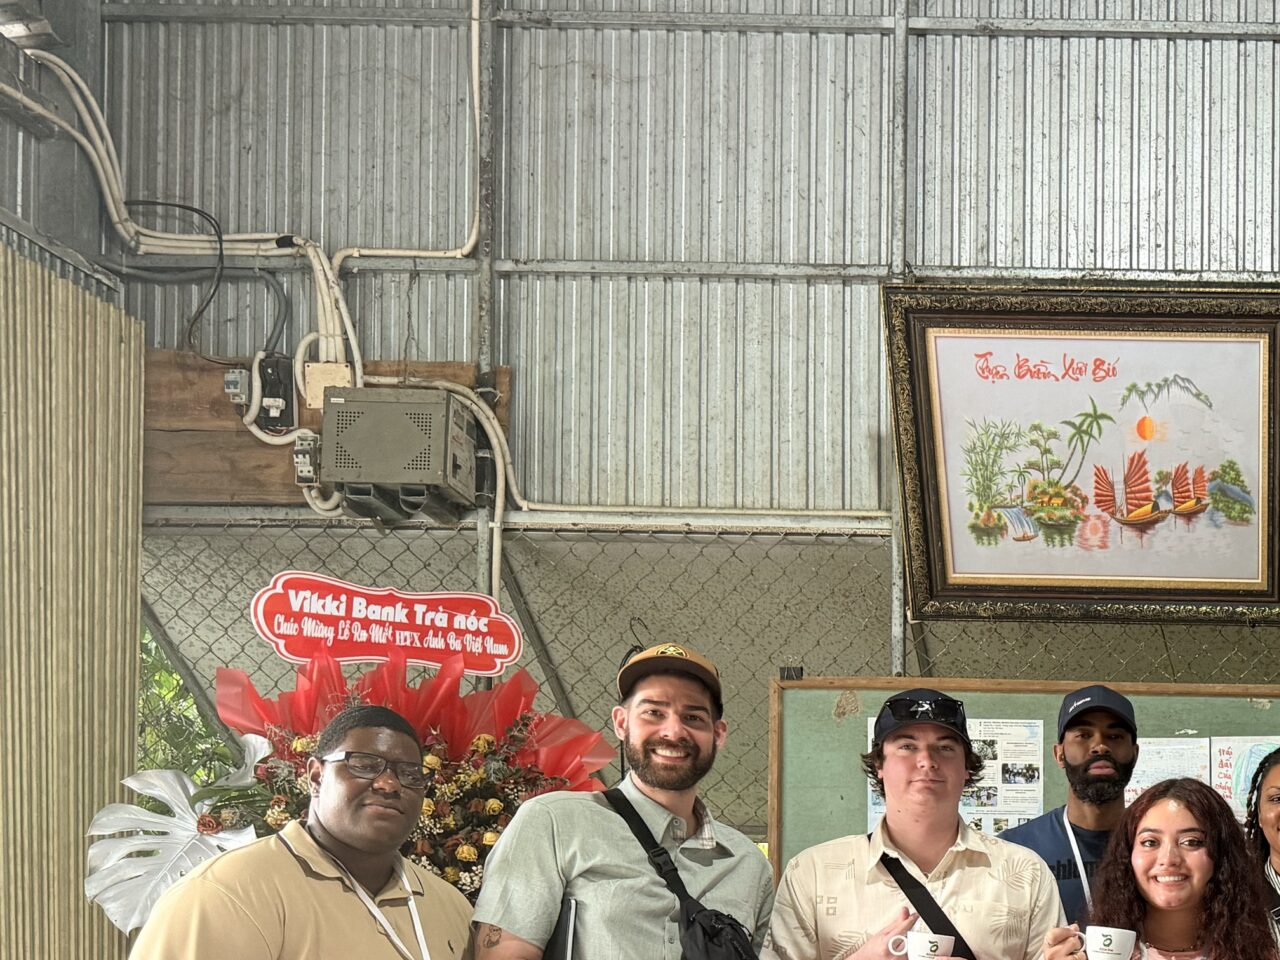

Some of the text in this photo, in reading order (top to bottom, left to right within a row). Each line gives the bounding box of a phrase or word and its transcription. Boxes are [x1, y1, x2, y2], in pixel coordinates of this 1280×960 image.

[288, 589, 489, 633] Vikki Bank Trà nóc
[274, 613, 299, 636] Chúc
[301, 616, 335, 646] Mừng
[352, 621, 368, 642] Ra
[395, 630, 422, 647] HTX
[464, 633, 483, 656] Việt
[484, 635, 509, 655] Nam
